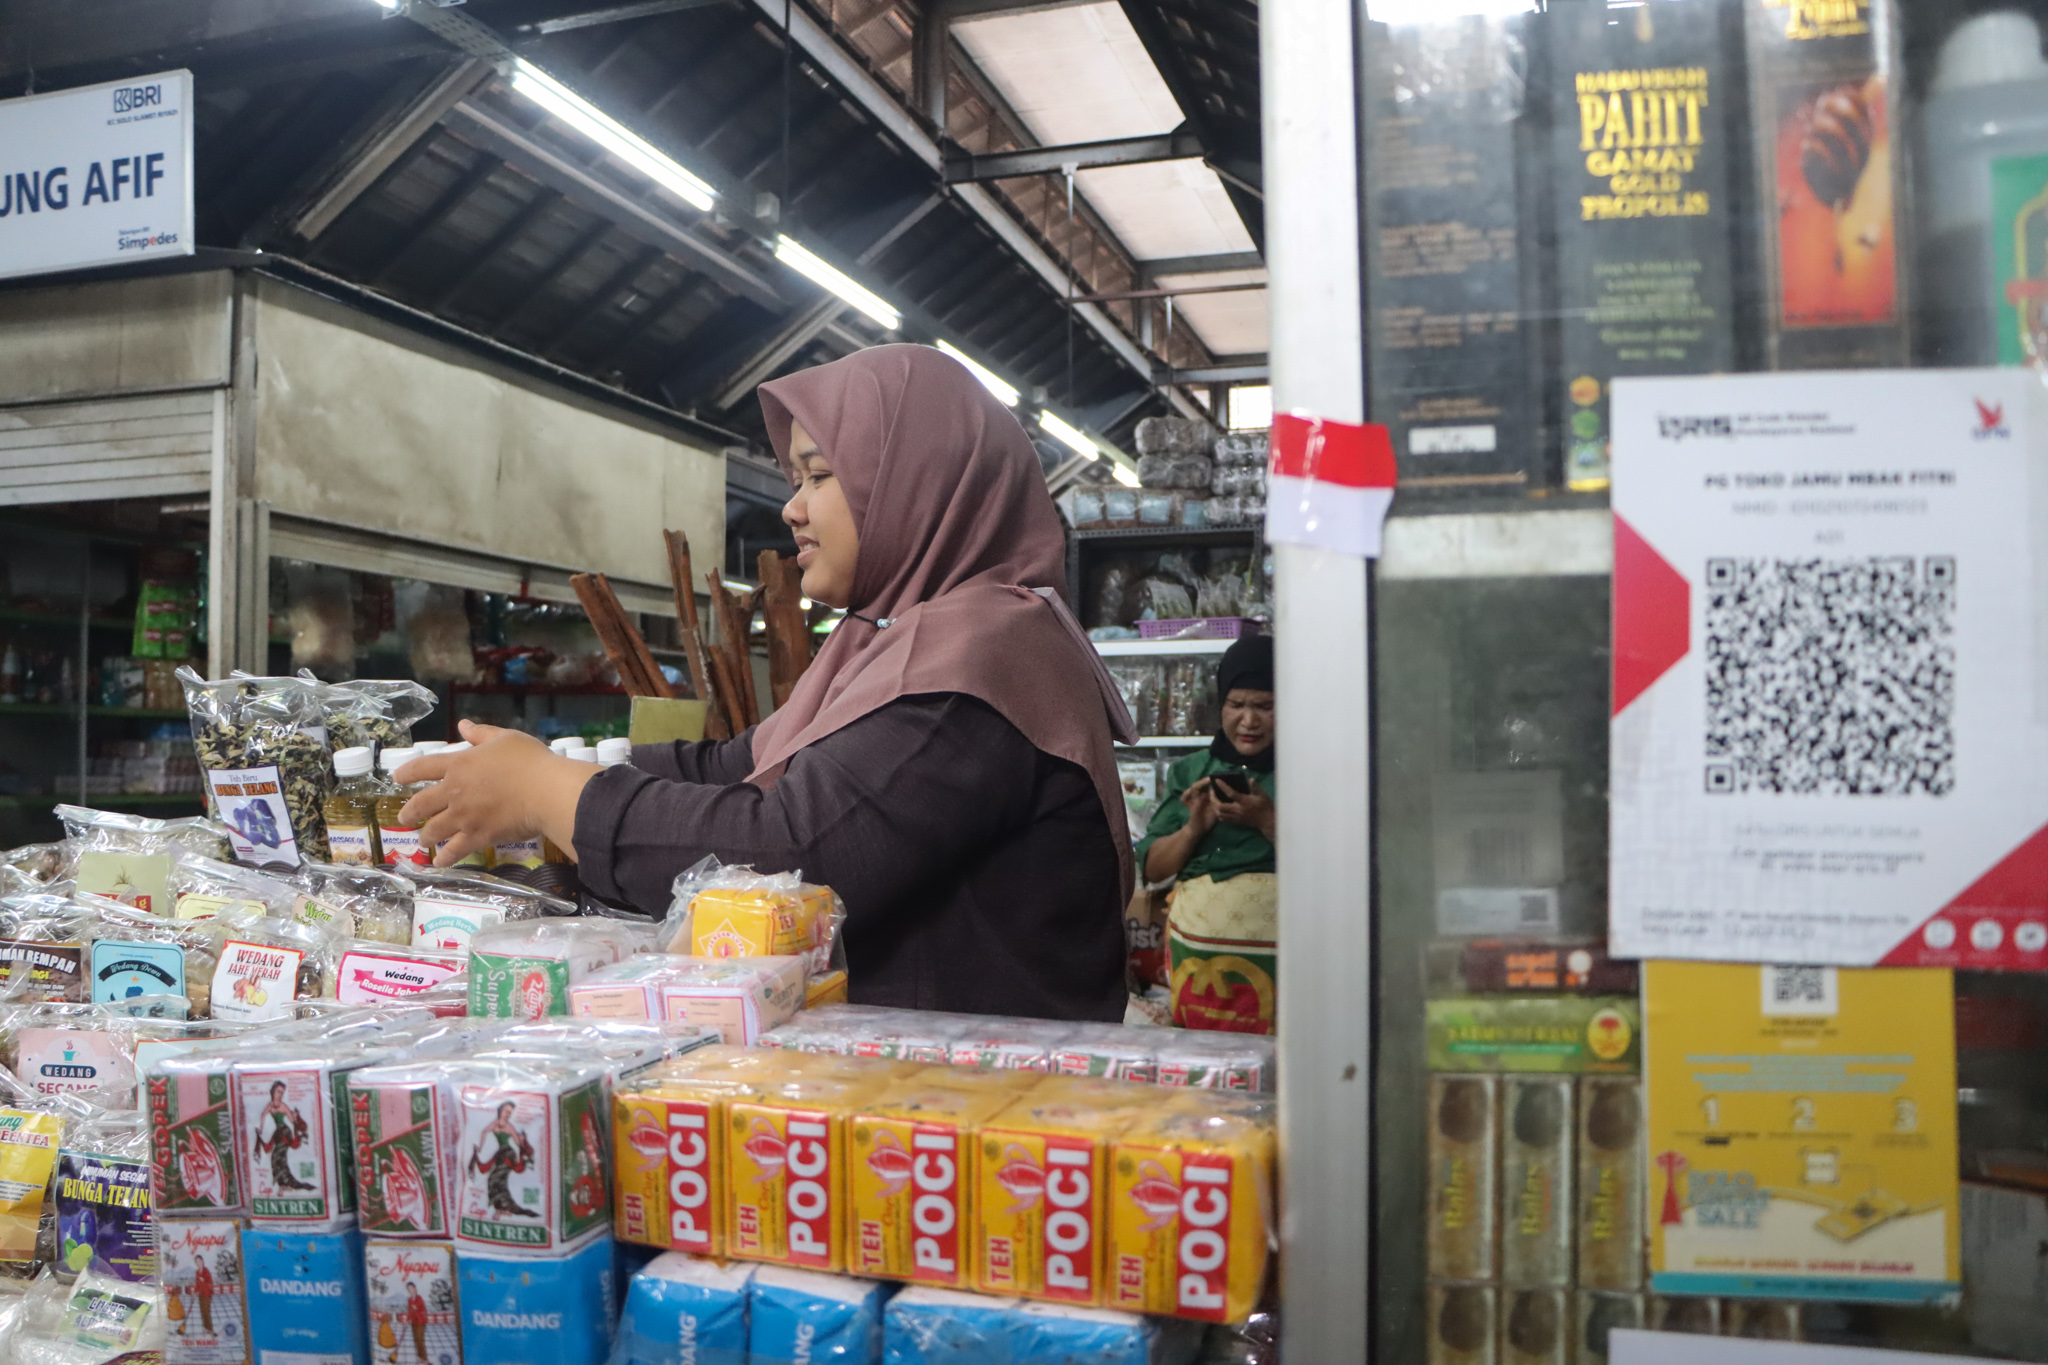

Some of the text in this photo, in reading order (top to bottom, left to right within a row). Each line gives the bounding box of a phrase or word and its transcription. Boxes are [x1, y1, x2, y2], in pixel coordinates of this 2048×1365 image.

[133, 85, 161, 108] BRI
[1579, 90, 1703, 150] PAHIT
[1586, 148, 1699, 177] GAMAT
[82, 152, 164, 206] AFIF
[1610, 173, 1681, 195] GOLD
[1581, 191, 1709, 220] PROPOLIS
[118, 232, 178, 251] Simpedes
[1735, 473, 1784, 488] TOKO
[1791, 472, 1842, 487] JAMU
[1848, 471, 1901, 486] MBAK
[1909, 470, 1956, 485] FITRI
[215, 781, 278, 796] BUNGA TELANG
[328, 836, 366, 845] MASSAGE OIL
[382, 837, 407, 845] MASSAGE
[427, 920, 454, 930] Wedang
[778, 914, 796, 930] TEH
[26, 949, 77, 975] REMPAH
[236, 949, 285, 968] WEDANG
[228, 963, 282, 981] JAHE MERAH
[384, 970, 424, 984] Wedang
[361, 978, 394, 995] Rosella
[45, 1066, 92, 1078] WEDANG
[150, 1077, 172, 1168] GOPEK
[216, 1111, 233, 1155] SLAWI
[0, 1130, 49, 1147] EENTEA
[351, 1093, 374, 1187] GOPEK
[420, 1130, 435, 1178] SLAWI
[119, 1170, 148, 1183] SEGAR
[668, 1112, 709, 1243] POCI
[787, 1120, 828, 1256] POCI
[1688, 1169, 1756, 1191] SOLO
[62, 1177, 103, 1203] BUNGA
[107, 1184, 152, 1209] TELAN
[913, 1133, 956, 1273] POCI
[255, 1200, 319, 1215] SINTREN
[626, 1194, 644, 1237] TEH
[1045, 1148, 1091, 1290] POCI
[1697, 1206, 1760, 1229] SALE
[463, 1220, 541, 1242] SINTREN
[739, 1204, 759, 1250] TEH
[1177, 1165, 1230, 1309] POCI
[171, 1226, 227, 1255] Nyapu
[862, 1221, 882, 1267] TEH
[379, 1252, 440, 1282] Nyapu
[990, 1237, 1013, 1284] TEH
[259, 1277, 342, 1297] DANDANG
[1120, 1256, 1142, 1301] TEH
[472, 1309, 562, 1330] DANDANG
